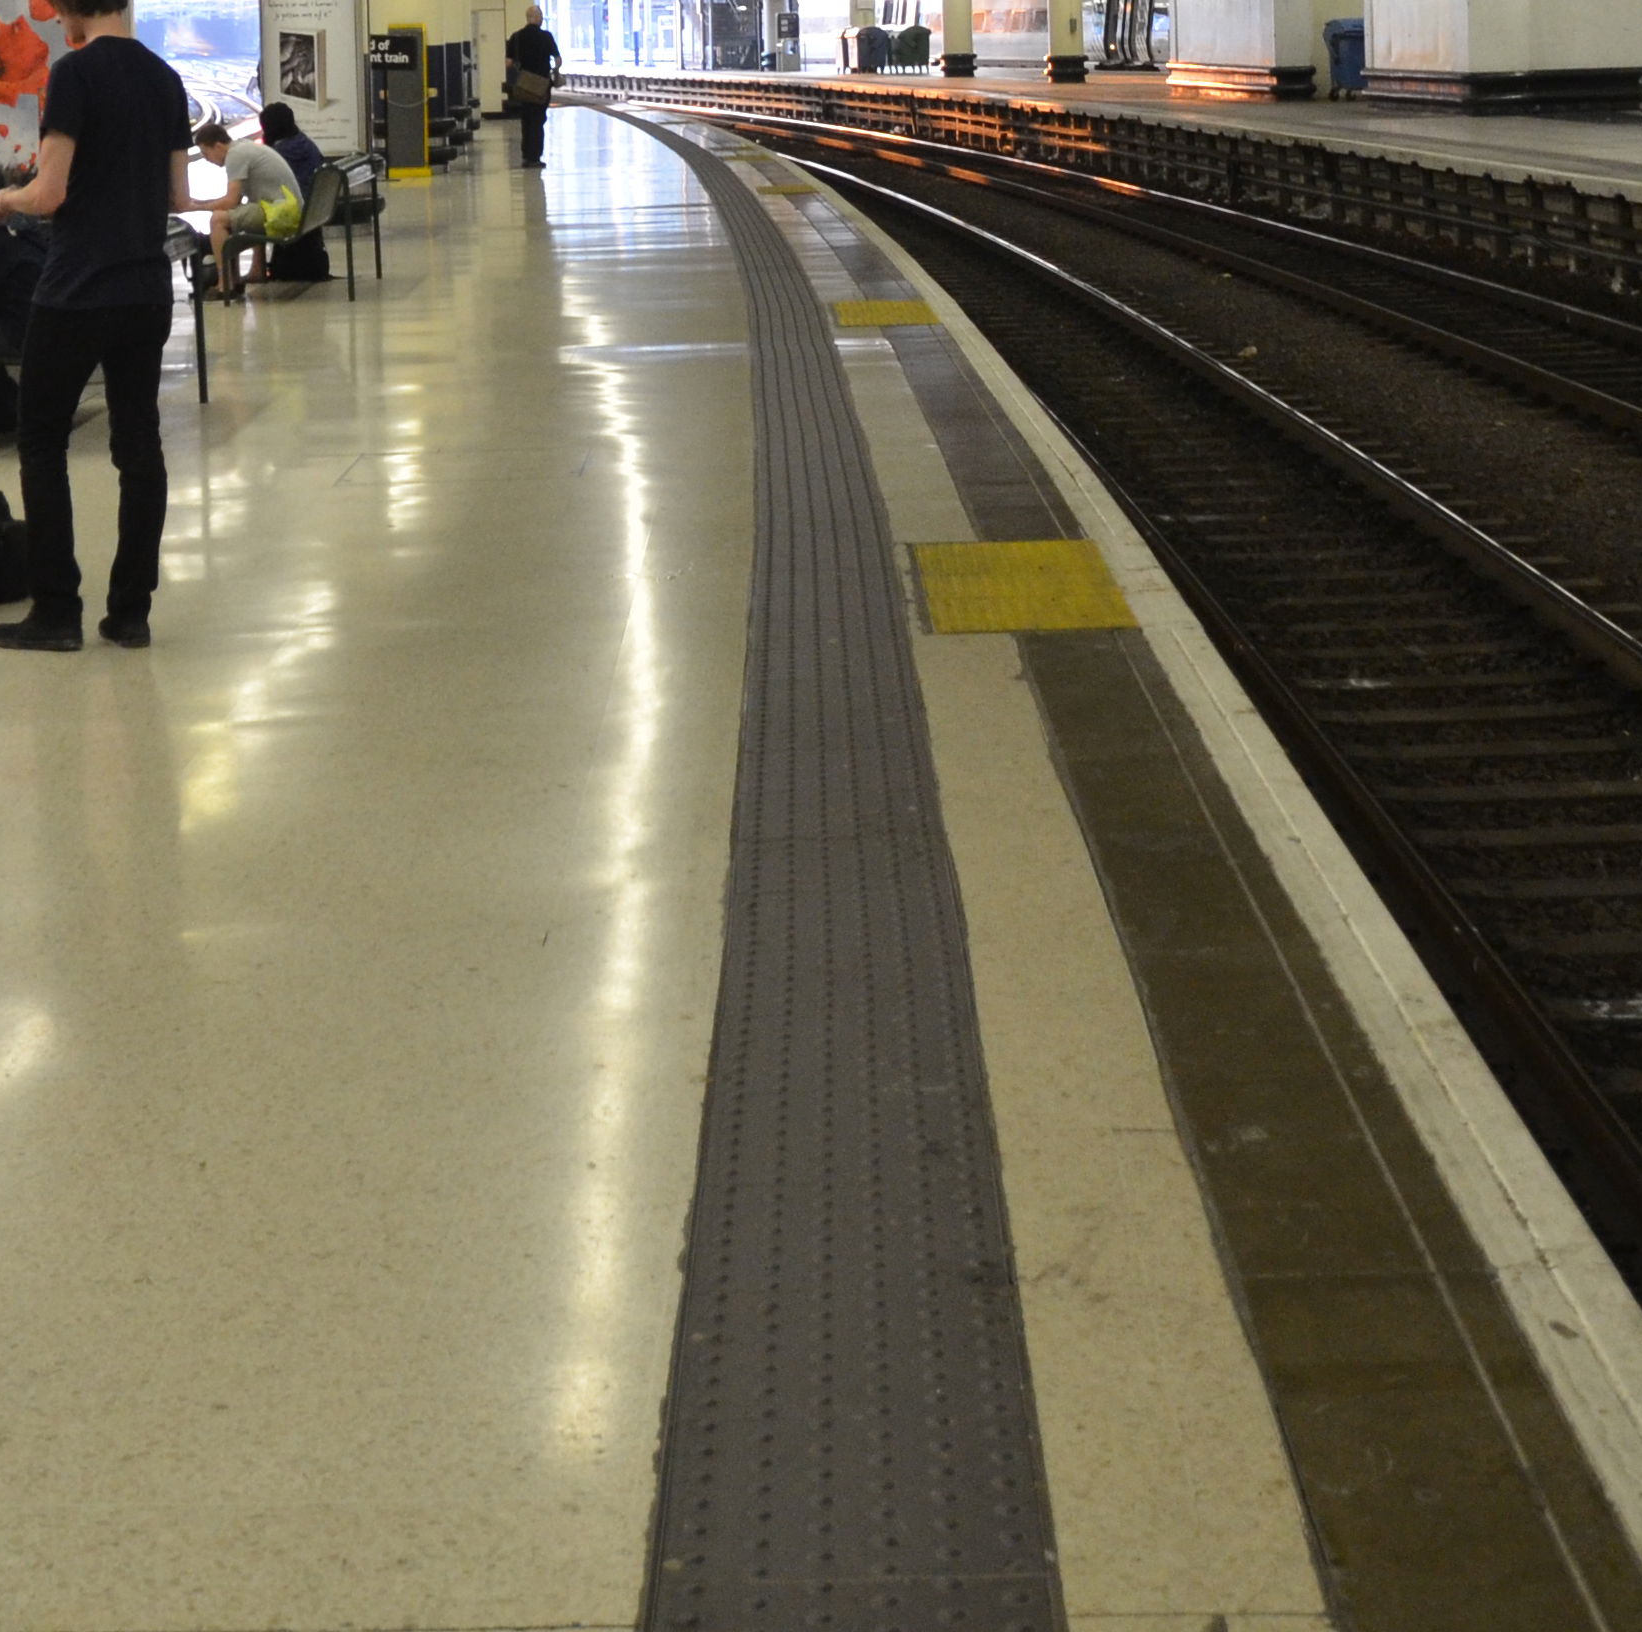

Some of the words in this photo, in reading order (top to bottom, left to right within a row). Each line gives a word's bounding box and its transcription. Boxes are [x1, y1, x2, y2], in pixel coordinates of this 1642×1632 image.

[378, 39, 390, 50] of
[370, 52, 382, 63] nt
[384, 52, 409, 63] train
